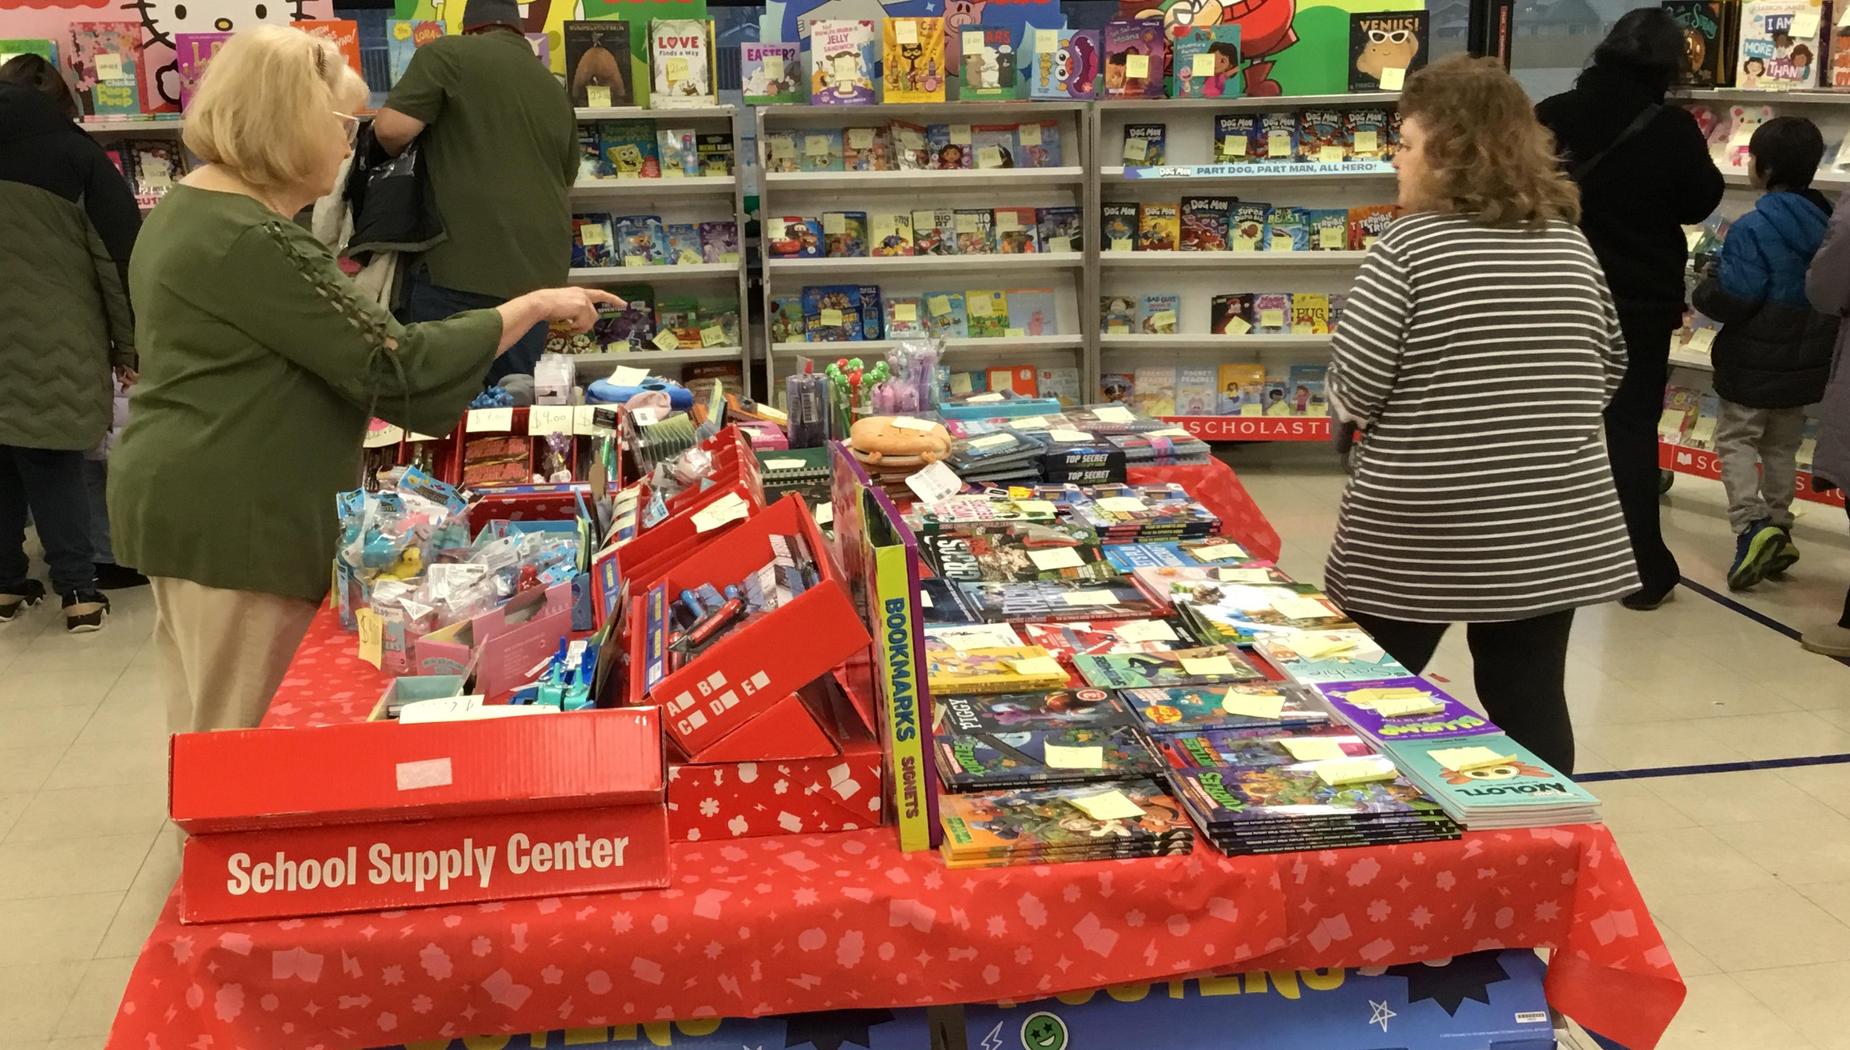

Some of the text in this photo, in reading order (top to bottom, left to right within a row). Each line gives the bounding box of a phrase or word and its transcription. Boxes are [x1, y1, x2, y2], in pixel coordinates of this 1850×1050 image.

[1360, 18, 1419, 32] VENUS!
[658, 36, 699, 49] LOVE
[827, 33, 848, 44] JELLY
[747, 48, 796, 62] EASTER?
[1745, 42, 1774, 56] MORE
[1769, 61, 1798, 79] THAN
[1197, 167, 1226, 175] PART
[1228, 166, 1254, 175] DOG,
[1257, 165, 1286, 173] PART
[1289, 164, 1317, 173] MAN,
[1320, 164, 1339, 172] ALL
[1190, 421, 1330, 434] SCHOLASTI
[1065, 453, 1109, 464] TOP SECRET
[1068, 469, 1110, 480] TOP SECRET
[885, 597, 916, 743] BOOKMARKS
[948, 697, 984, 731] PIGGY
[902, 756, 919, 819] SIGNETS
[1454, 782, 1569, 797] AXOLOTL
[226, 832, 630, 896] School Supply Center
